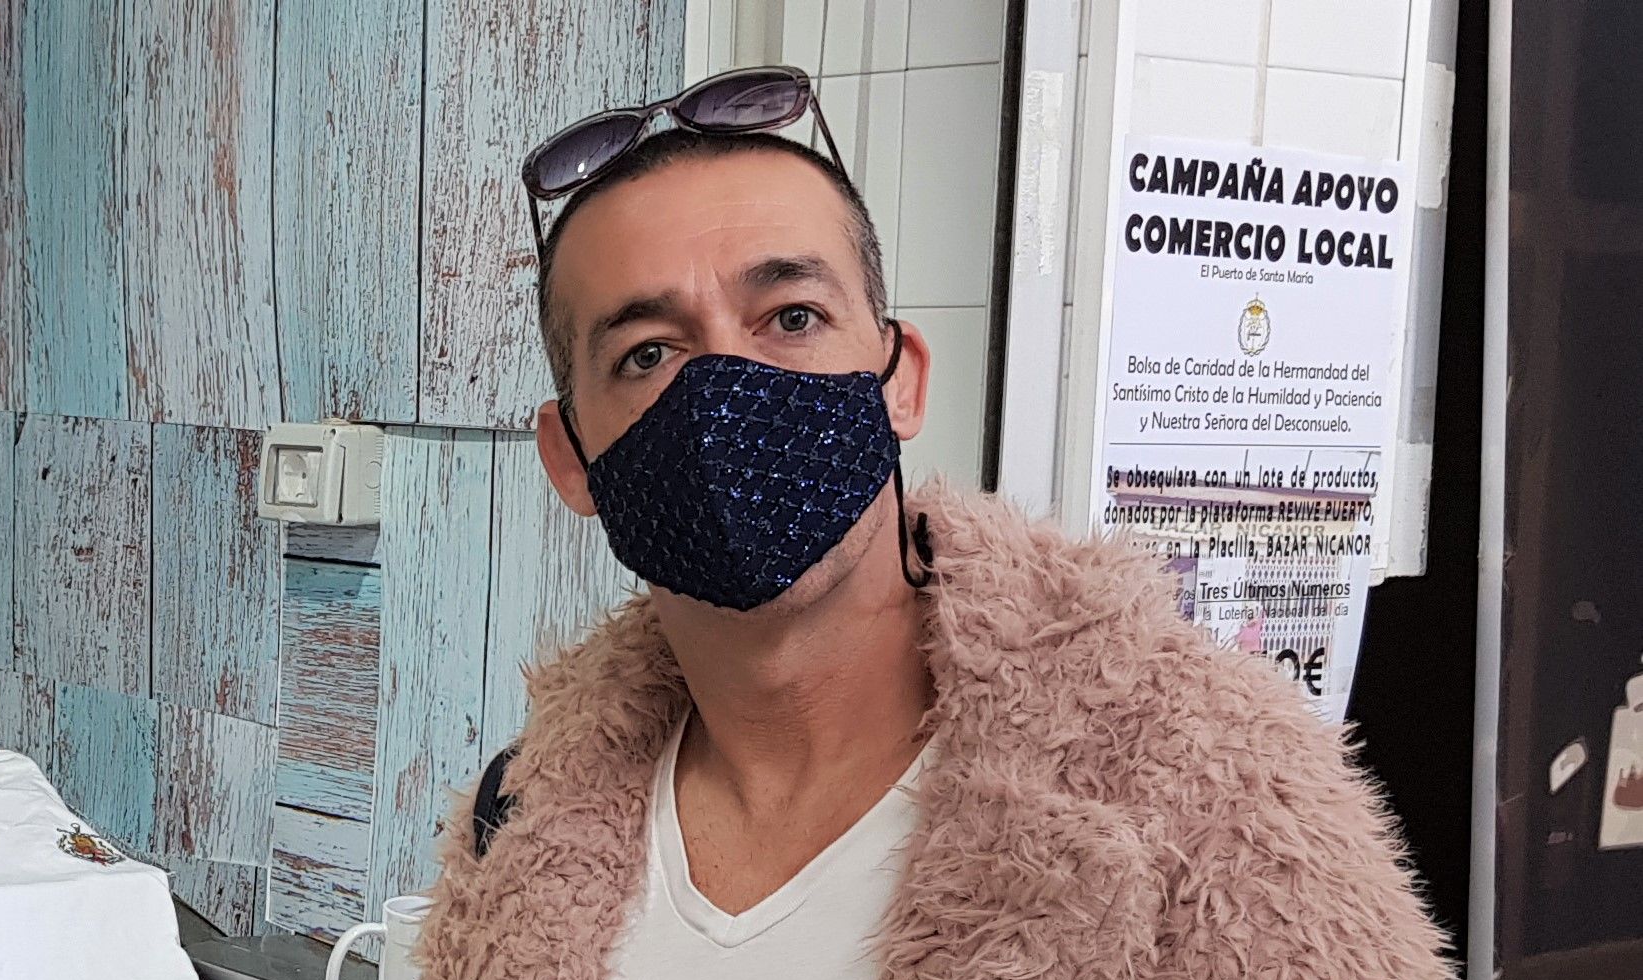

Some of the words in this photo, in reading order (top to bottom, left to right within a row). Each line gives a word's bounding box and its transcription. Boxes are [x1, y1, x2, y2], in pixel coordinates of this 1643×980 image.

[1129, 153, 1283, 204] CAMPAÑA
[1291, 169, 1398, 214] APOYO
[1125, 213, 1285, 262] COMERCIO
[1297, 228, 1393, 270] LOCAL
[1201, 264, 1209, 278] El
[1212, 265, 1243, 280] Puerto
[1246, 268, 1257, 280] de
[1259, 268, 1284, 282] Santa
[1287, 270, 1314, 284] María
[1128, 355, 1161, 374] Bolsa
[1164, 357, 1181, 375] de
[1184, 357, 1235, 377] Caridad
[1238, 360, 1254, 377] de
[1258, 360, 1270, 377] la
[1273, 360, 1348, 380] Hermandad
[1351, 364, 1370, 381] del
[1113, 382, 1171, 402] Santísimo
[1175, 384, 1209, 402] Cristo
[1212, 386, 1228, 403] de
[1232, 386, 1244, 404] la
[1247, 386, 1311, 405] Humildad
[1313, 393, 1322, 409] y
[1325, 389, 1382, 407] Paciencia
[1139, 416, 1148, 432] y
[1151, 411, 1201, 430] Nuestra
[1204, 412, 1248, 431] Señora
[1252, 413, 1271, 431] del
[1274, 413, 1352, 432] Desconsuelo.
[1106, 465, 1120, 488] Se
[1204, 470, 1227, 488] con
[1234, 470, 1250, 488] un
[1258, 465, 1284, 488] lote
[1290, 465, 1306, 488] de
[1312, 465, 1378, 494] productos,
[1104, 500, 1157, 524] donados
[1158, 505, 1181, 530] por
[1185, 500, 1195, 523] la
[1199, 500, 1274, 530] plataforma
[1277, 501, 1321, 522] REVIVE
[1323, 500, 1375, 526] PUERTO,
[1189, 535, 1200, 558] la
[1267, 535, 1307, 557] BAZAR
[1316, 535, 1371, 556] NICANOR
[1200, 582, 1228, 600] Tres
[1234, 577, 1286, 599] Últimos
[1291, 579, 1351, 598] Números
